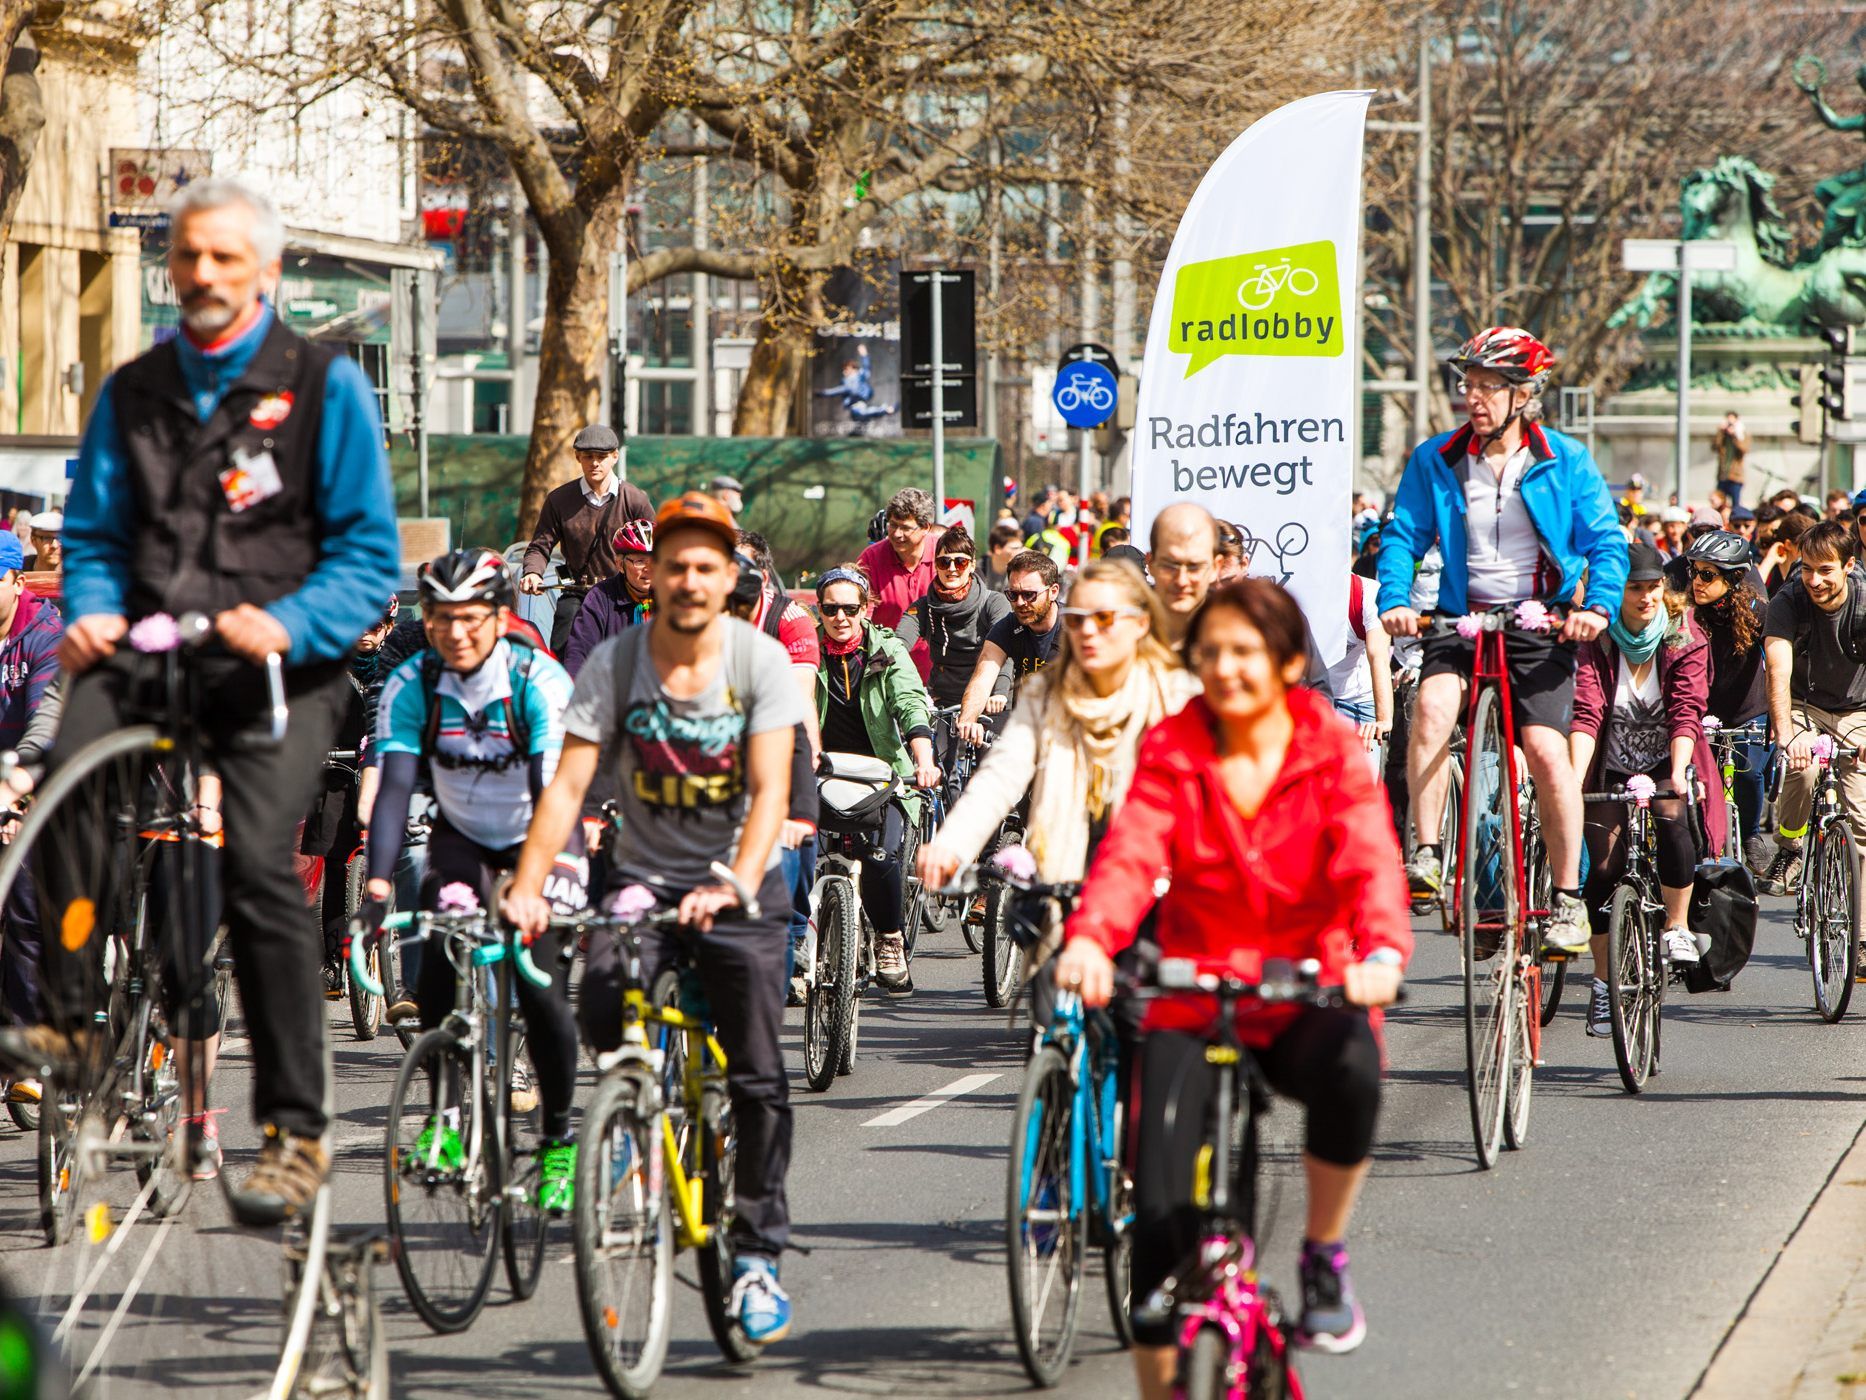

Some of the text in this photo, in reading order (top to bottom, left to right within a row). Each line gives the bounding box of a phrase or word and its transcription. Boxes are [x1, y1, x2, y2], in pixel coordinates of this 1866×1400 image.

[1181, 312, 1335, 345] radlobby
[1148, 412, 1344, 449] Radfahren
[1170, 455, 1313, 496] bewegt
